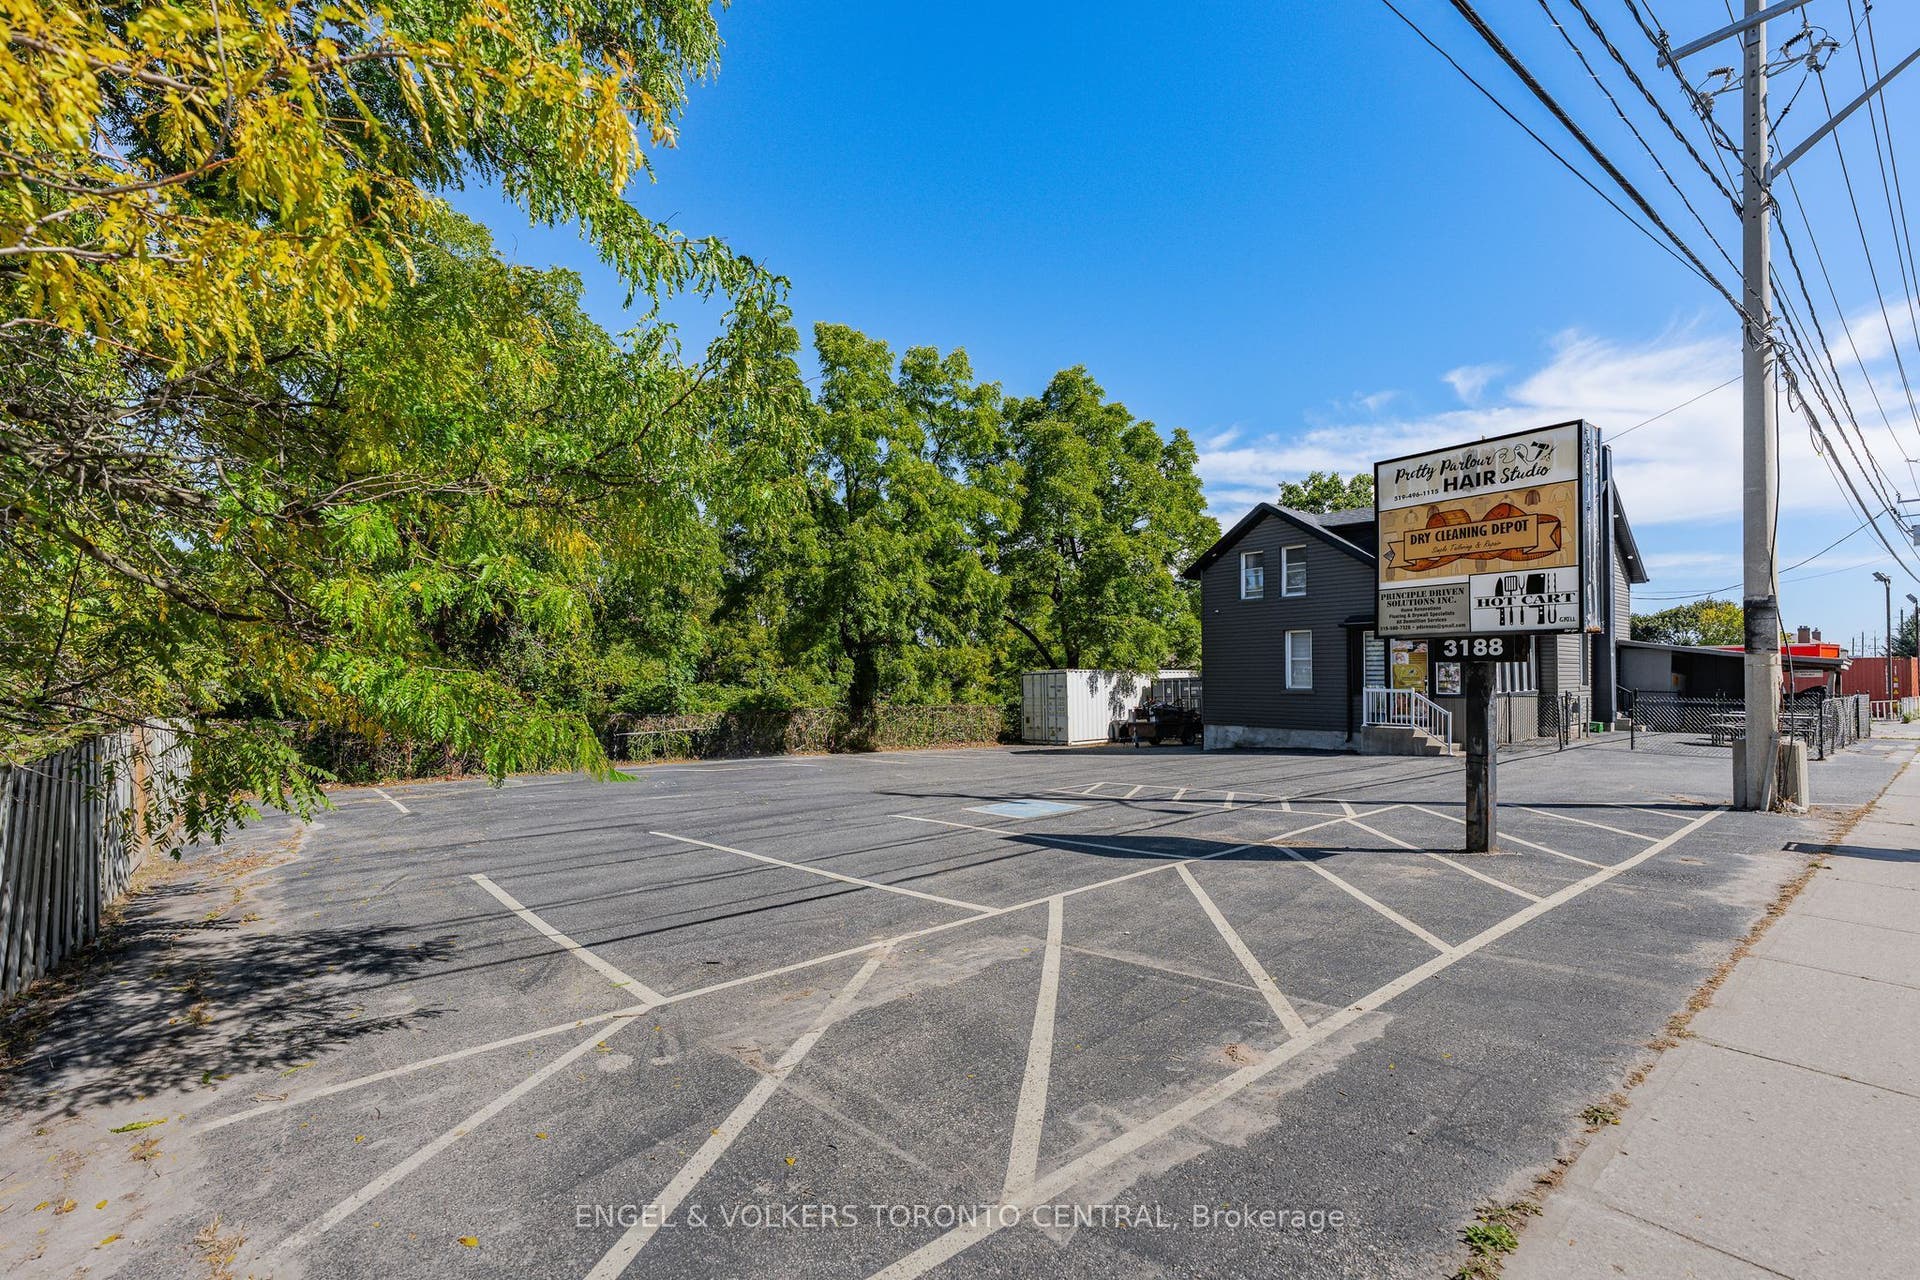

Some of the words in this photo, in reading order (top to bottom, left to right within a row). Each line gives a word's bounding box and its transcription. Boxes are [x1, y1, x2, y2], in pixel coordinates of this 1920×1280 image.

[1394, 463, 1437, 484] Pretty
[1440, 454, 1494, 476] Parlour
[1443, 471, 1496, 492] HAIR
[1500, 461, 1550, 484] Studio
[1394, 489, 1439, 502] 519-496-1115
[1410, 532, 1431, 545] DRY
[1435, 524, 1488, 542] CLEANING
[1491, 519, 1529, 535] DEPOT
[1380, 590, 1427, 601] PRINCIPLE
[1429, 587, 1465, 597] DRIVEN
[1386, 597, 1435, 608] SOLUTIONS
[1437, 595, 1457, 605] INC.
[1477, 597, 1517, 608] HOT
[1521, 593, 1576, 606] CART
[1443, 638, 1504, 657] 3188
